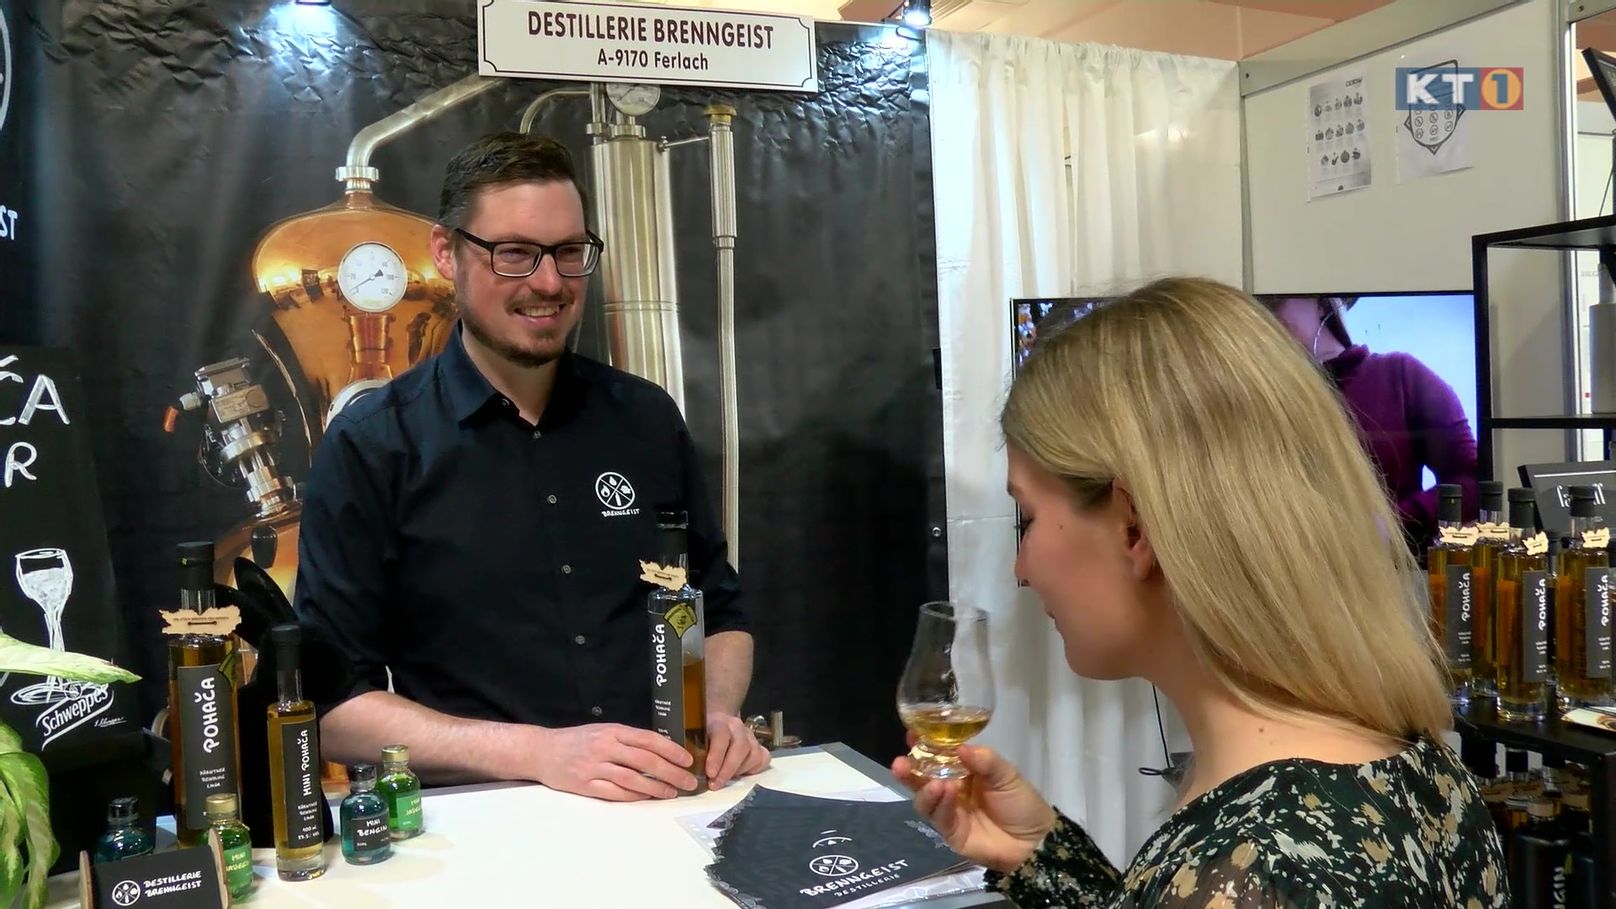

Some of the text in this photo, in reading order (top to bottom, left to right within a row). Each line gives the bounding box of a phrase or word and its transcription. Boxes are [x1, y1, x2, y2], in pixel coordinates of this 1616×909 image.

[527, 10, 774, 50] DESTILLERIE BRENNGEIST
[597, 48, 709, 70] A-9170 Ferlach
[4, 441, 37, 488] R
[652, 623, 668, 687] POHAČA
[42, 682, 109, 737] Schweppes
[194, 677, 220, 753] POHAČA
[297, 729, 310, 772] POHAČA
[143, 870, 202, 888] DESTILLERIE
[144, 880, 202, 898] BRENNGEIST
[800, 859, 910, 897] BRENNGEIST
[834, 873, 900, 897] DESTILLERIE
